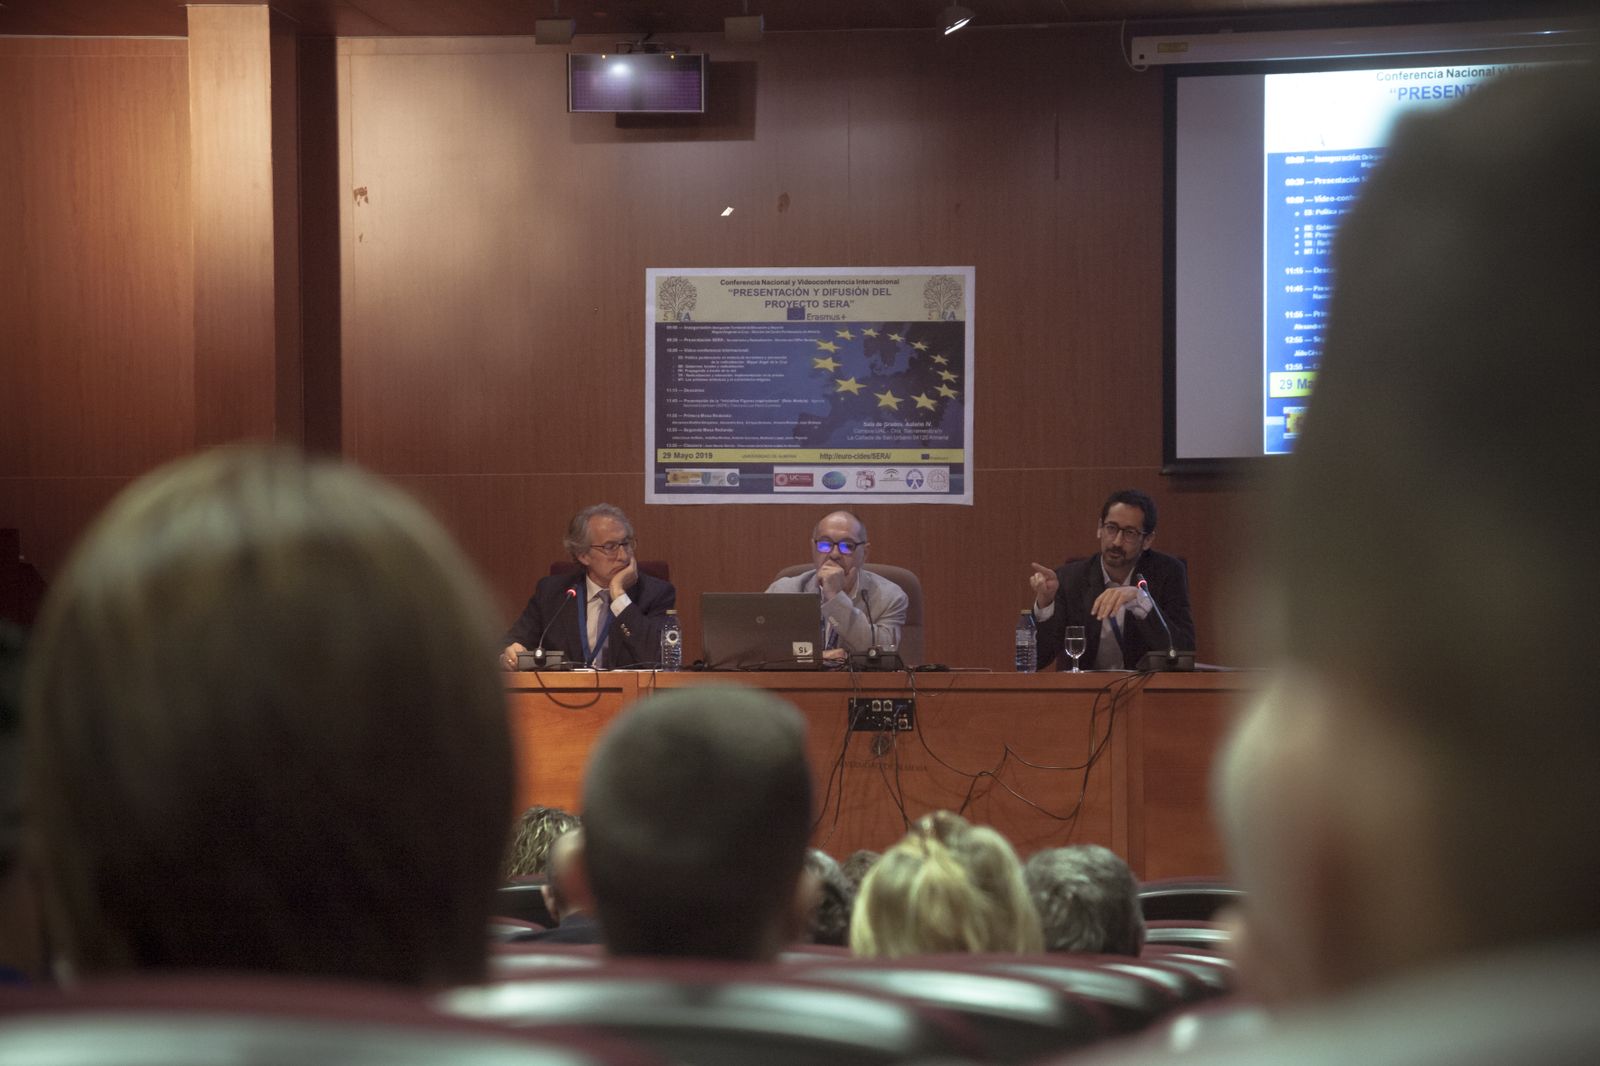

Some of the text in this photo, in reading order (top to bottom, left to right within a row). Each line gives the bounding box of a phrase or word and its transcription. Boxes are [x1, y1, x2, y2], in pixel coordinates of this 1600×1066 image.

[1376, 69, 1443, 82] Conferencia
[1446, 66, 1495, 79] Nacional
[813, 288, 820, 296] Y
[822, 286, 870, 297] DIFUSIÓN
[872, 287, 892, 296] DEL
[764, 300, 820, 309] PROYECTO
[1279, 379, 1293, 390] 29
[662, 451, 672, 459] 29
[673, 451, 694, 461] Mayo
